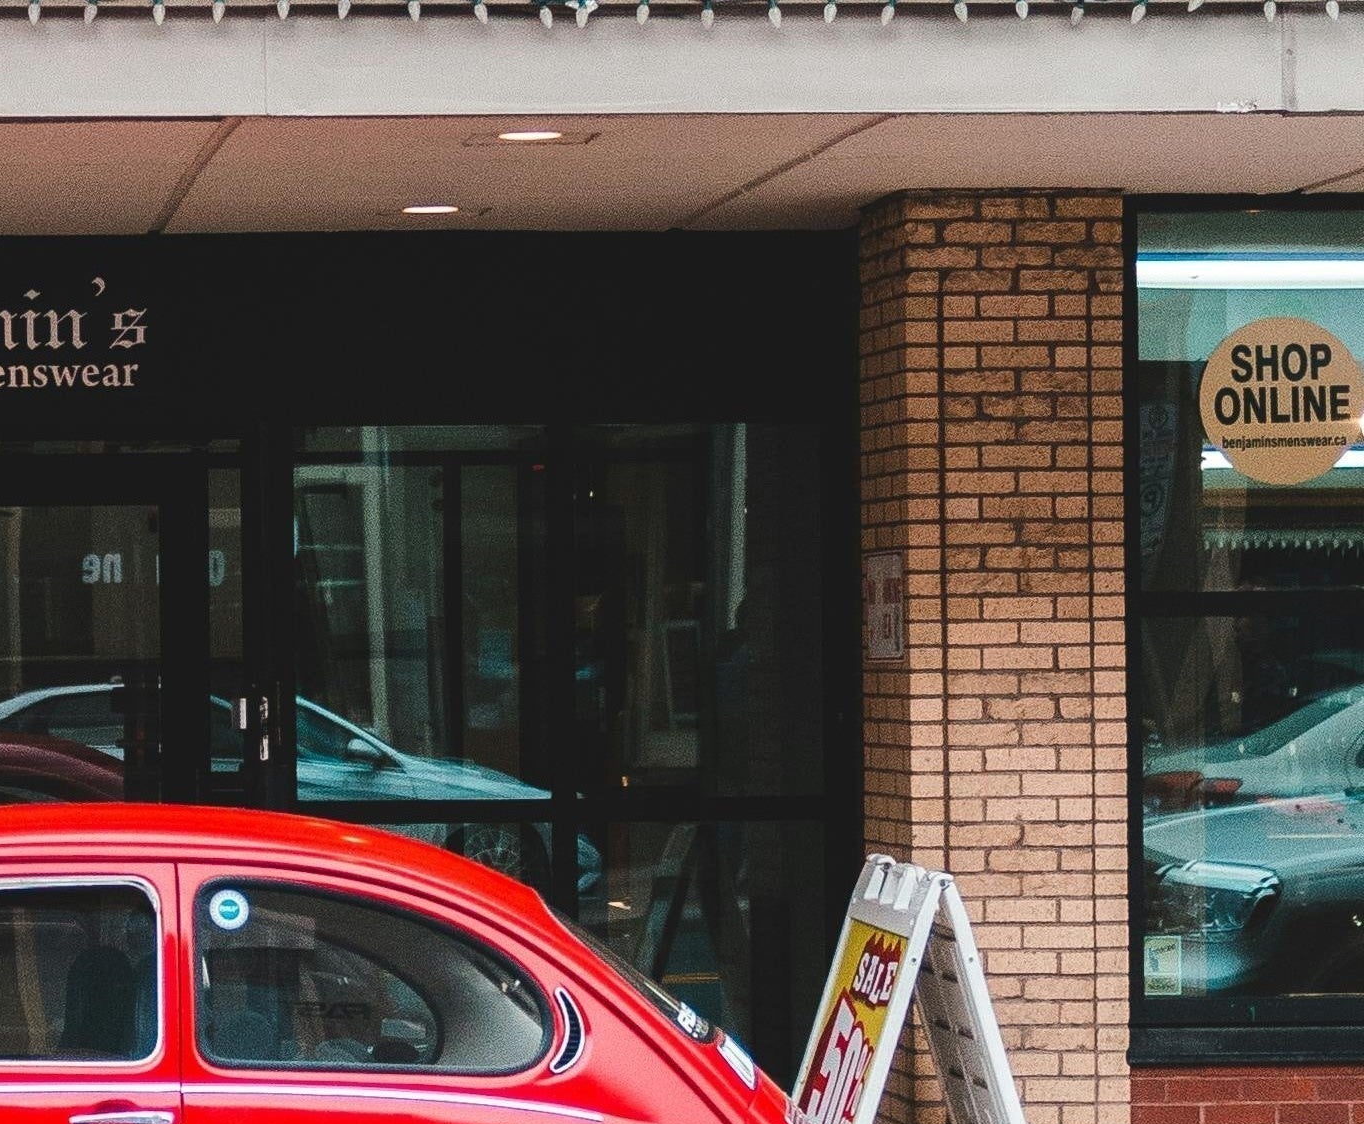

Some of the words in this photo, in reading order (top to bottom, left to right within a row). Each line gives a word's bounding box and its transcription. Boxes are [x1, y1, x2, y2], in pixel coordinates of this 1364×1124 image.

[1230, 343, 1332, 383] SHOP
[1214, 384, 1351, 426] ONLINE
[1222, 434, 1347, 452] benjaminsmenswear.ca
[852, 951, 899, 1005] SALE
